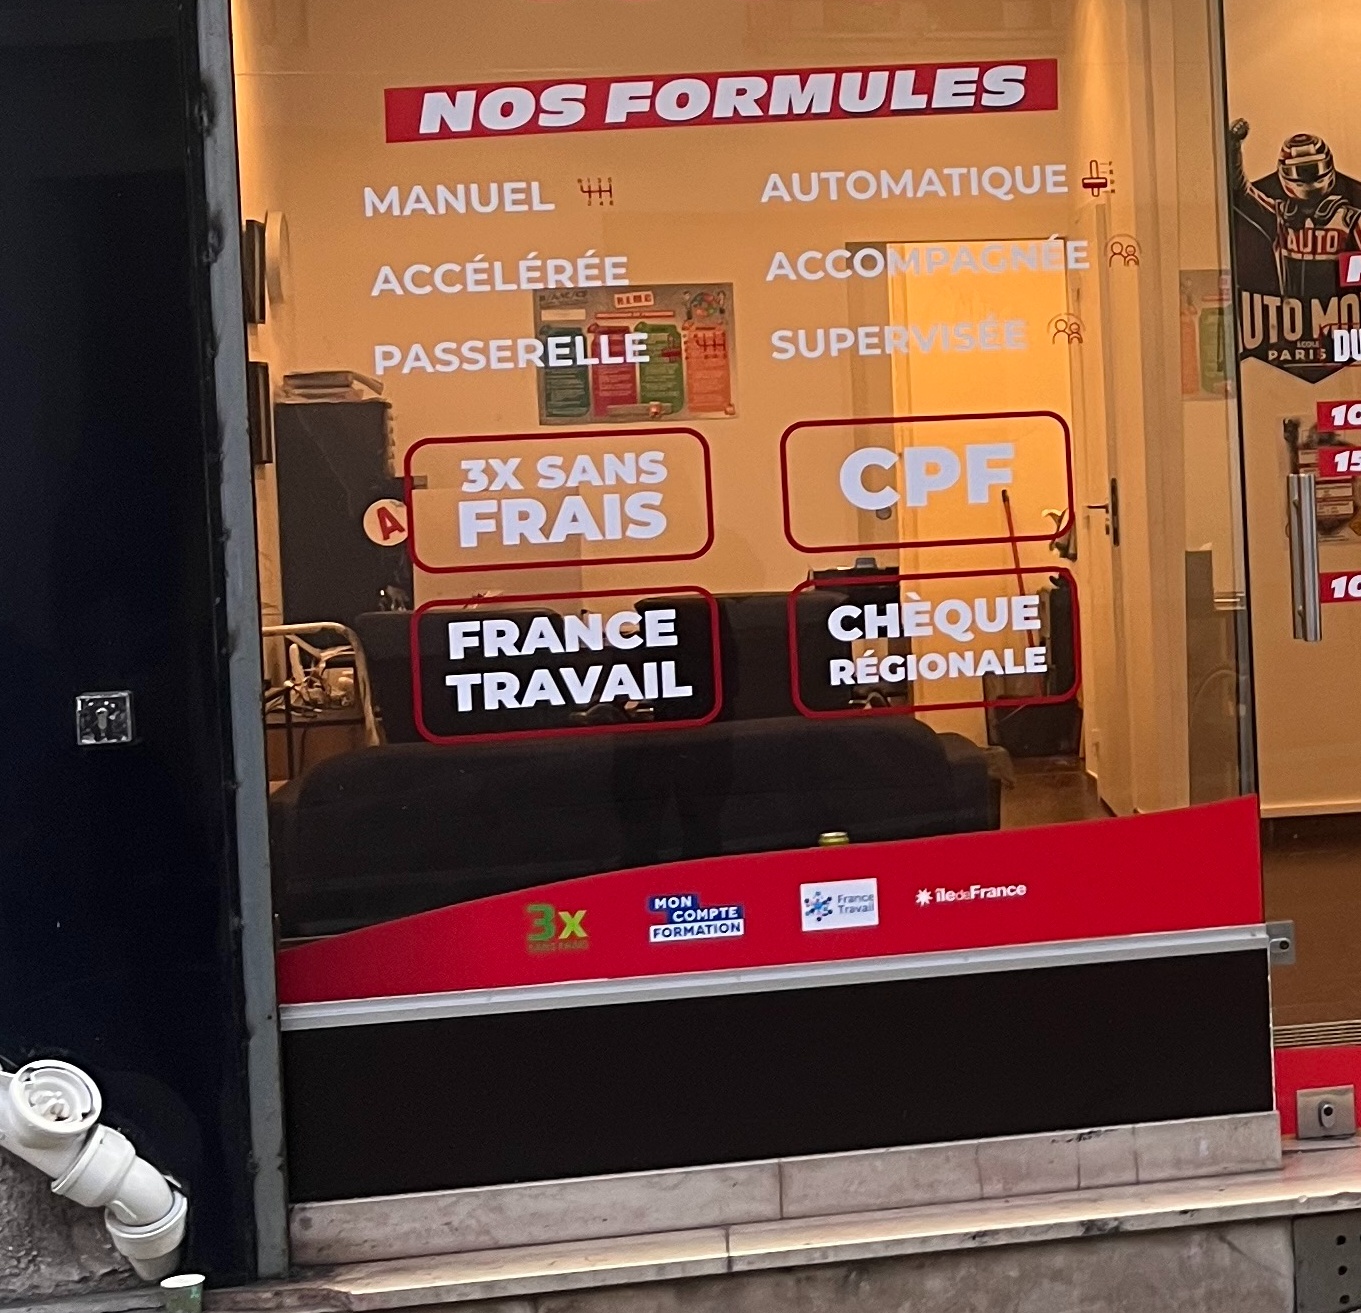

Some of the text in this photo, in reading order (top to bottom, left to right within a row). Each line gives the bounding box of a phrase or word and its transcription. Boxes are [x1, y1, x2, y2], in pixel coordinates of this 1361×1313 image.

[419, 65, 1027, 134] NOS FORMULES
[364, 181, 555, 217] MANUEL
[761, 164, 1068, 203] AUTOMATIQUE
[765, 233, 1090, 281] ACCOMPAGNÉE
[1287, 228, 1338, 253] AUTO
[371, 249, 629, 297] ACCÉLÉRÉE
[771, 313, 1029, 361] SUPERVISÉE
[1237, 290, 1303, 354] UTO
[374, 333, 650, 375] PASSERELLE
[1268, 348, 1327, 361] PARIS
[460, 451, 668, 493] 3X SANS
[839, 442, 1016, 511] CPF
[376, 506, 406, 541] A
[458, 491, 667, 548] FRAIS
[448, 609, 678, 660] FRANCE
[828, 592, 1041, 642] CHÈQUE
[445, 661, 693, 712] TRAVAIL
[829, 646, 1048, 686] RÉGIONALE
[654, 895, 693, 909] MON
[672, 906, 739, 923] COMPTE
[838, 894, 874, 904] France
[838, 902, 874, 914] Travail
[653, 922, 742, 939] FORMATION
